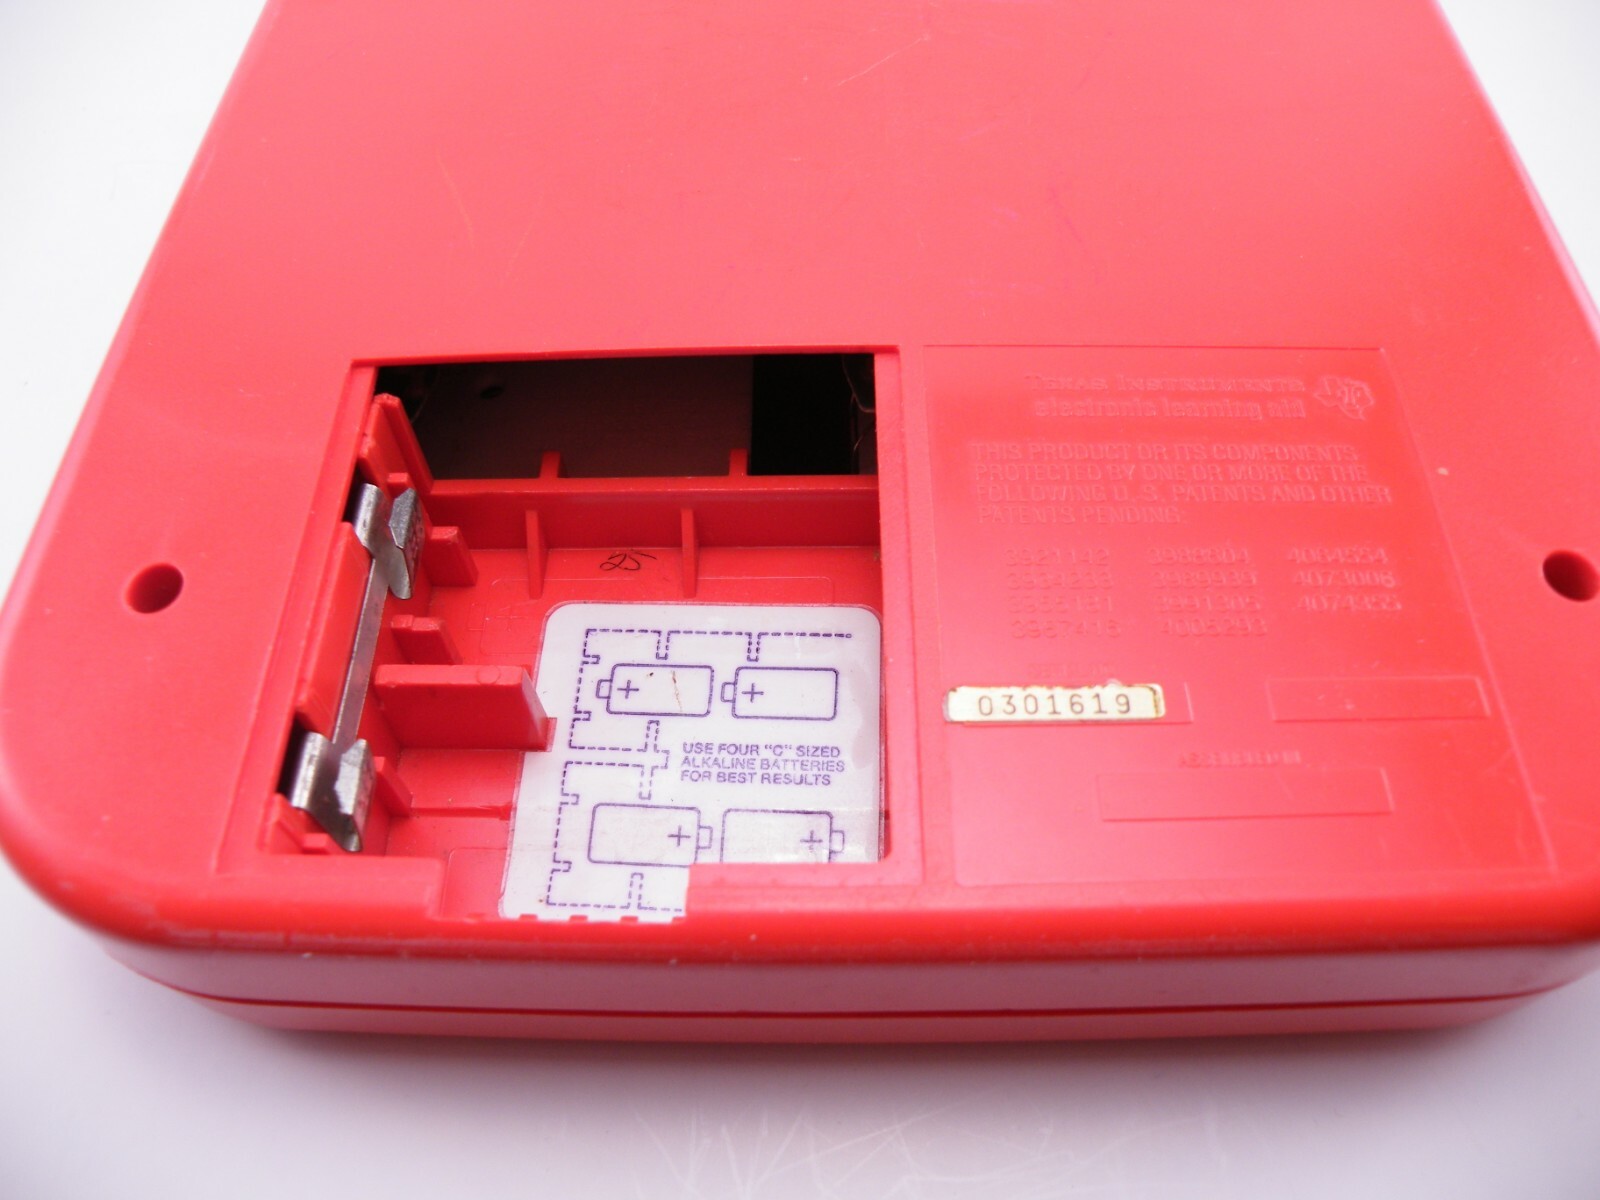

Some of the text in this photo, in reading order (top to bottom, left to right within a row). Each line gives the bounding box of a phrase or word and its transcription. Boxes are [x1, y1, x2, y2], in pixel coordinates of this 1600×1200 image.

[1024, 373, 1306, 392] TEXAS INSTRUMENTS
[1034, 397, 1307, 420] electronic learning aid
[970, 443, 1360, 461] THIS PRODUCT OR ITS COMPONENTS
[974, 463, 1369, 482] PROTECTED BY ONE OR MORE OF THE
[976, 484, 1106, 502] FOLLOWING
[1171, 485, 1266, 503] PATENTS
[1271, 485, 1316, 503] AND
[1320, 485, 1393, 504] OTHER
[978, 505, 1077, 524] PATENTS
[977, 693, 1132, 716] 0301619
[683, 741, 841, 758] USE FOUR "C" SIZED
[681, 756, 845, 772] ALKALINE BATTERIES
[681, 769, 831, 786] FOR BEST RESULTS
